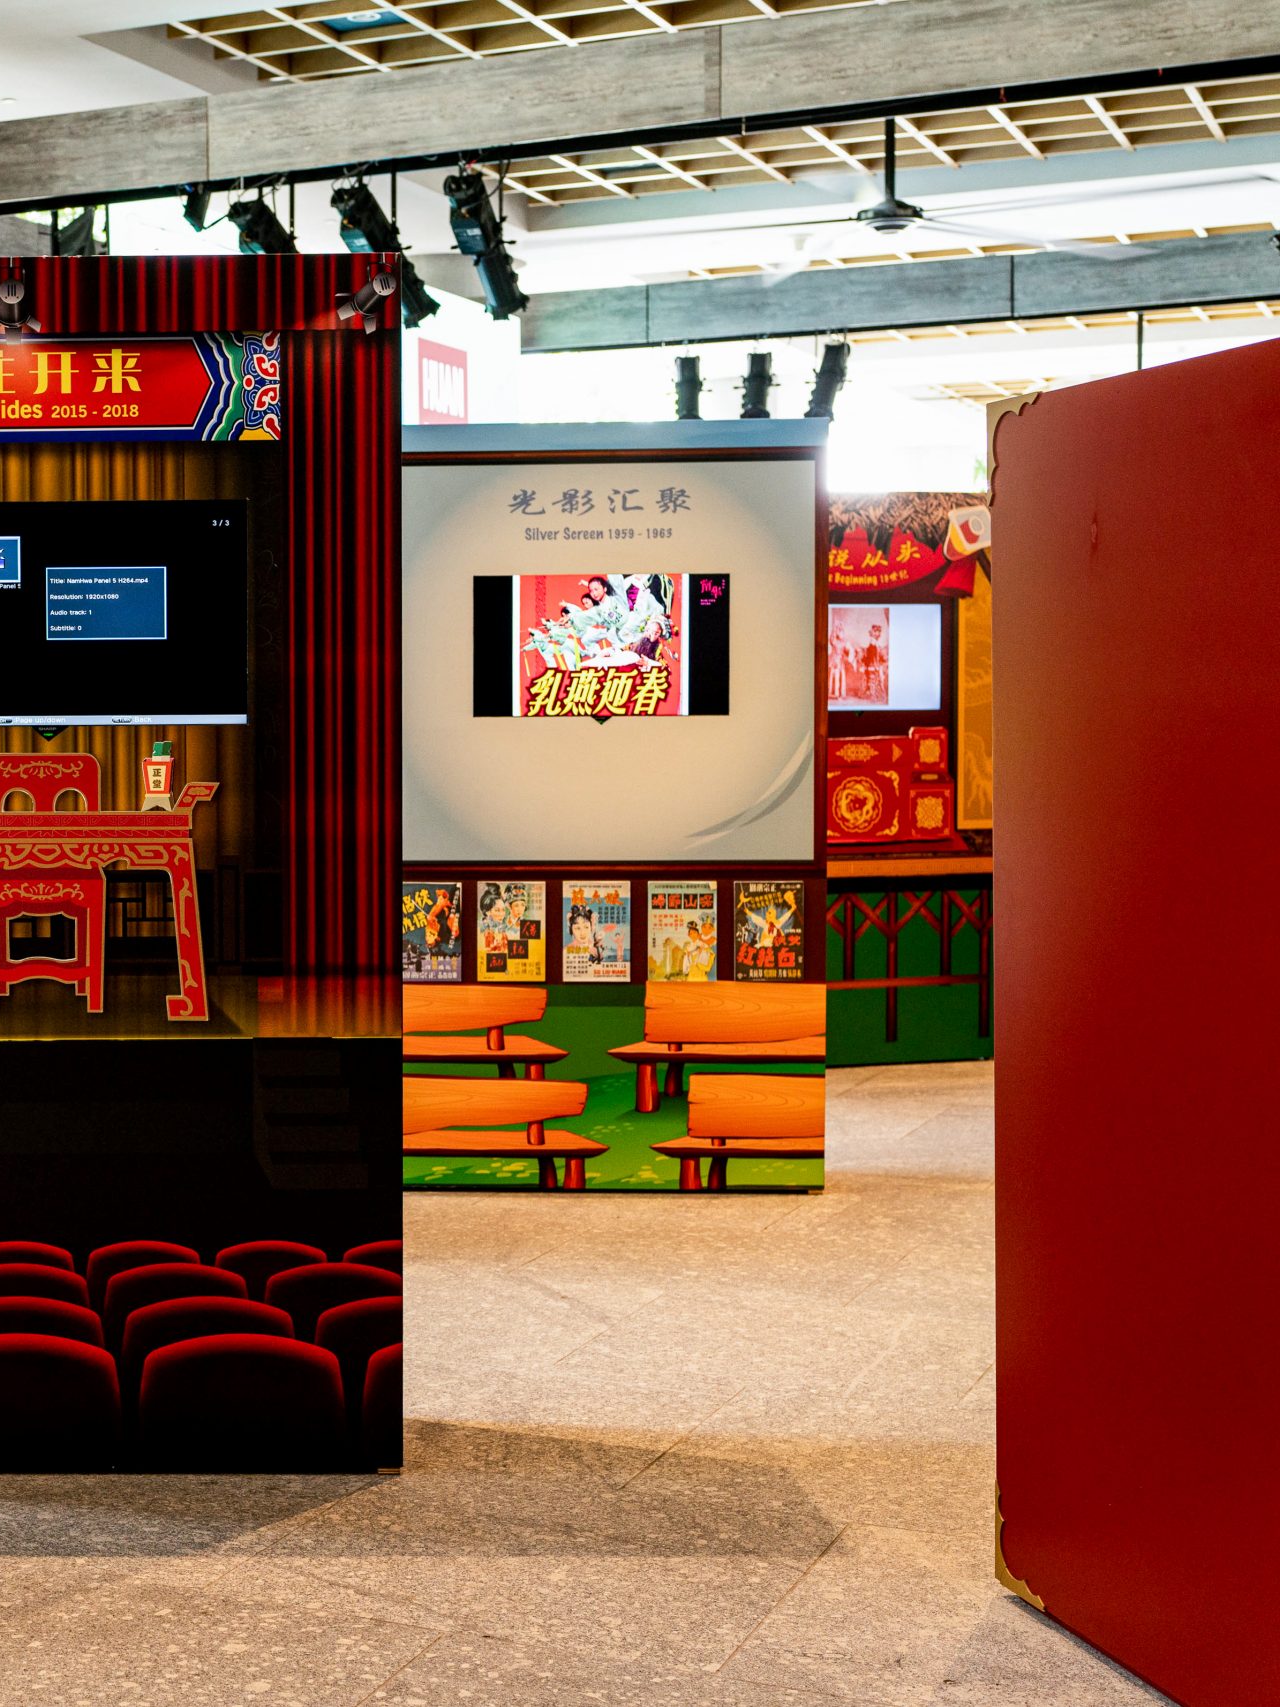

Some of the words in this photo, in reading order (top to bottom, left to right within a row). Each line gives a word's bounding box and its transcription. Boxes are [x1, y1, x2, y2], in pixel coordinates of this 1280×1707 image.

[51, 405, 88, 418] 2015
[102, 404, 139, 417] 2018
[508, 486, 692, 515] 光影汇聚
[212, 519, 217, 527] 3
[224, 519, 230, 527] 3
[525, 527, 559, 541] Silver
[563, 527, 604, 540] Screen
[608, 528, 634, 540] 1959
[834, 572, 878, 587] Beginning
[527, 667, 669, 716] 乳燕迎春
